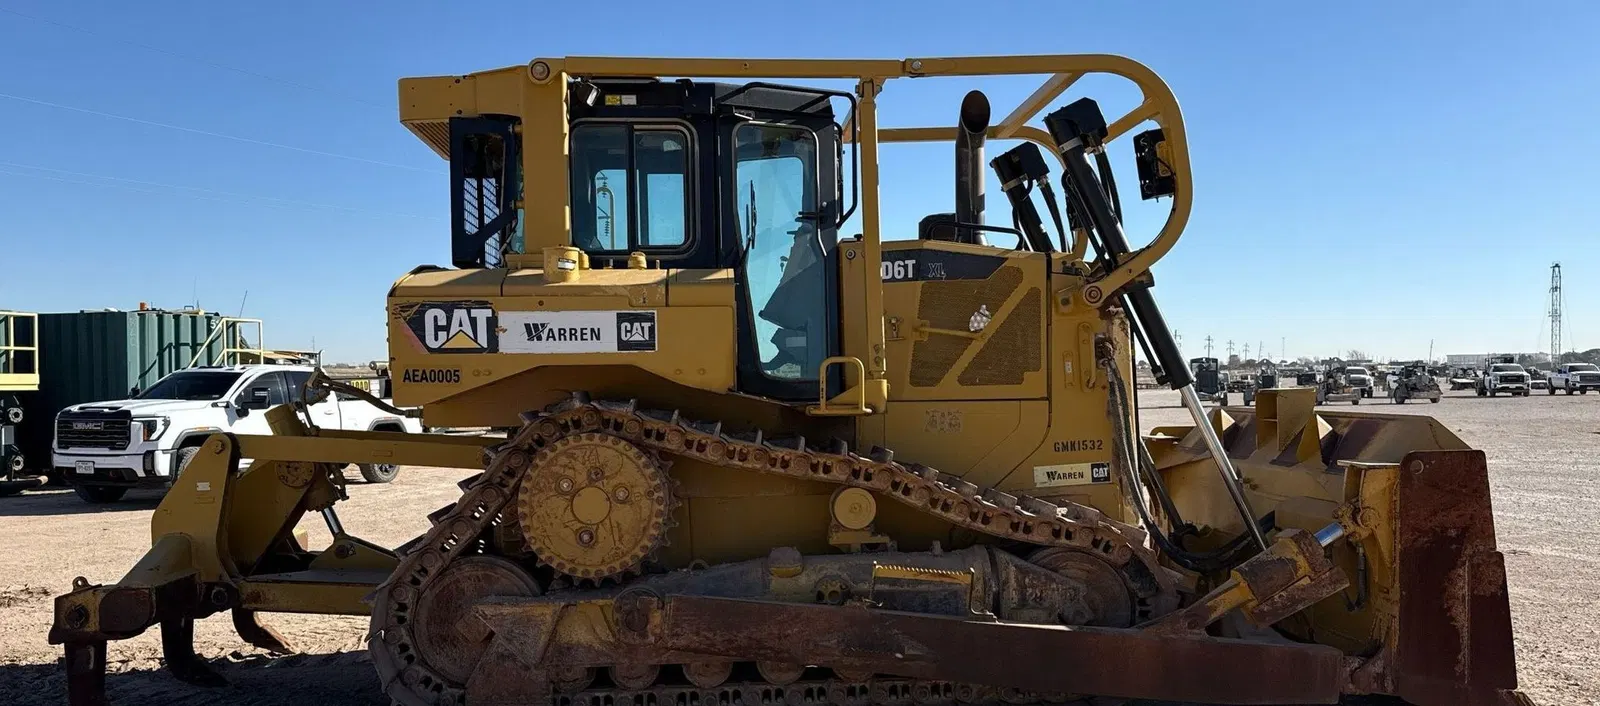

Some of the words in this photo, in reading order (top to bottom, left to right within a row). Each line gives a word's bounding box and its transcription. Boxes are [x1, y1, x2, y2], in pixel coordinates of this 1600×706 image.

[882, 260, 916, 280] D6T
[424, 308, 492, 349] CAT
[523, 322, 601, 342] WARREN
[620, 321, 653, 342] CAT
[402, 368, 461, 384] AEA0005
[73, 421, 104, 430] GMC
[1046, 470, 1084, 481] WARREN
[1093, 466, 1108, 478] CAT
